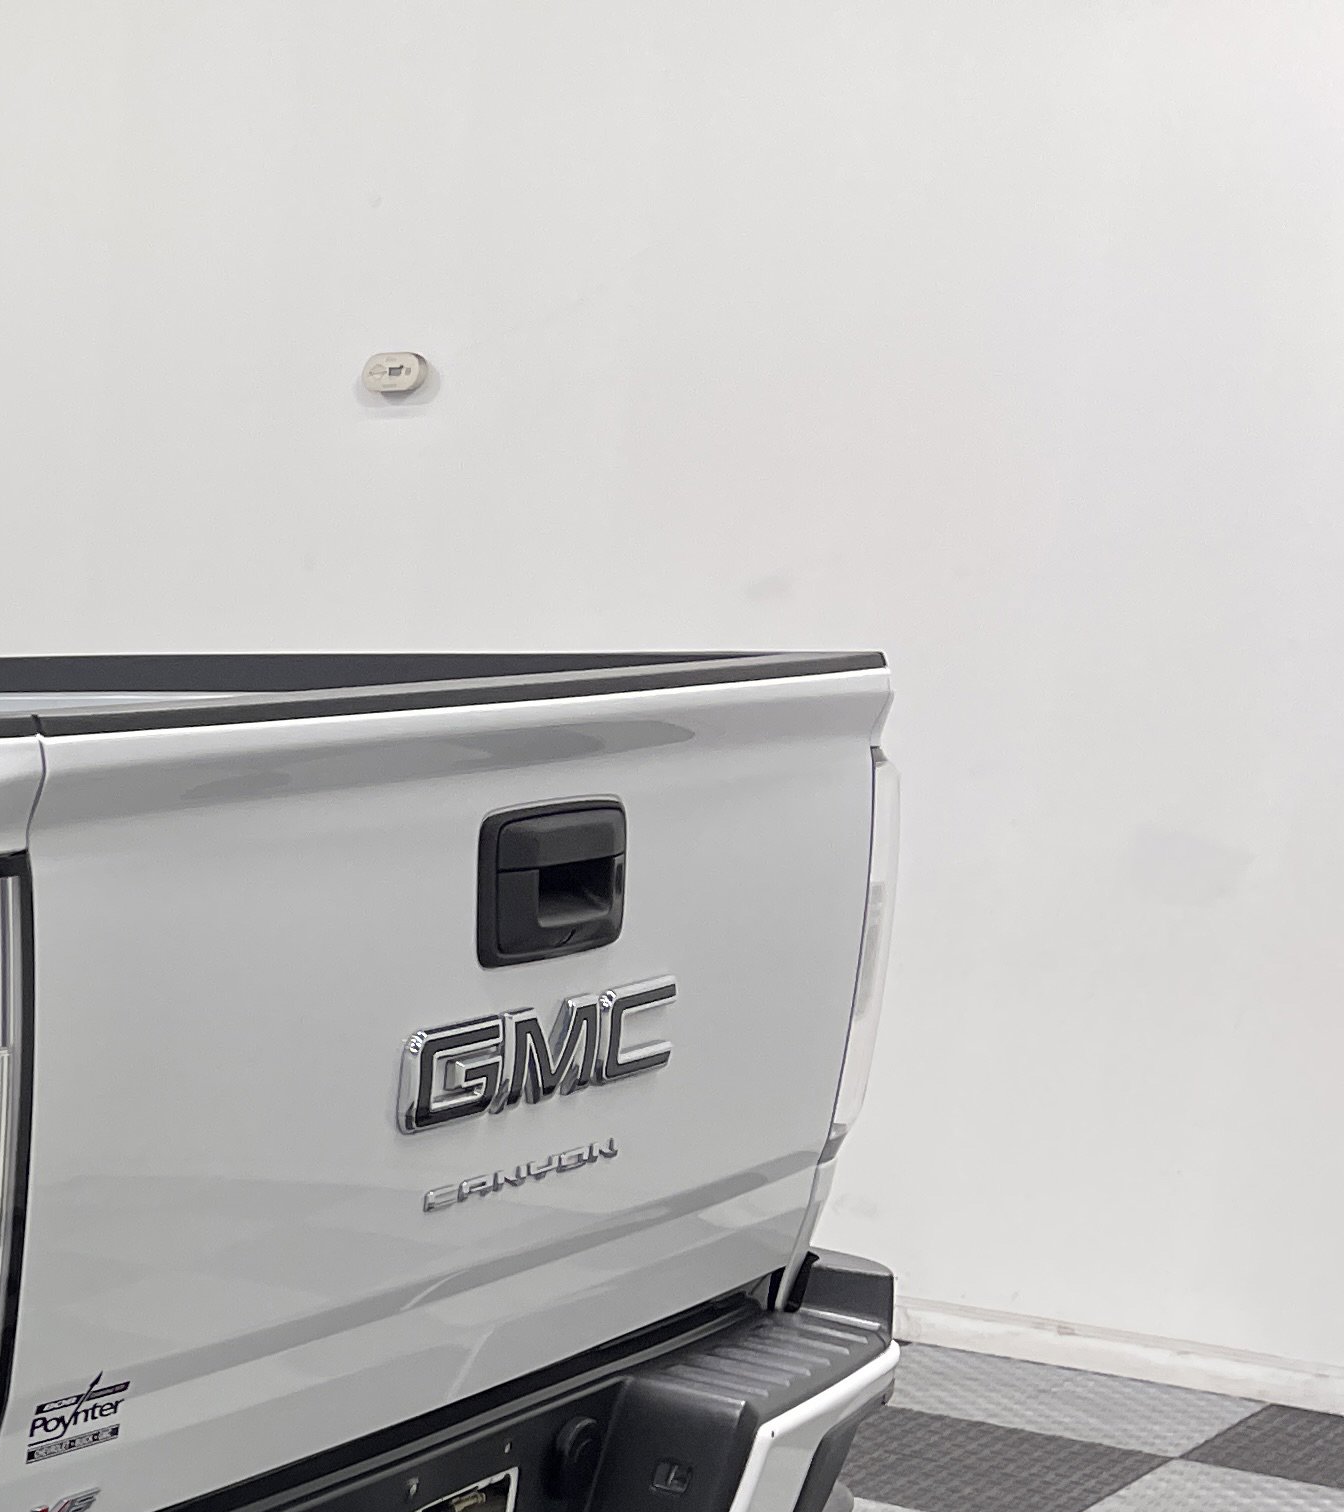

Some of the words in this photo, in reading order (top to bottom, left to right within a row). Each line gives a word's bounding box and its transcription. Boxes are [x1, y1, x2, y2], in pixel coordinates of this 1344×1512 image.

[397, 975, 678, 1135] GMC
[423, 1137, 619, 1213] CANYON
[27, 1397, 125, 1446] Poynter
